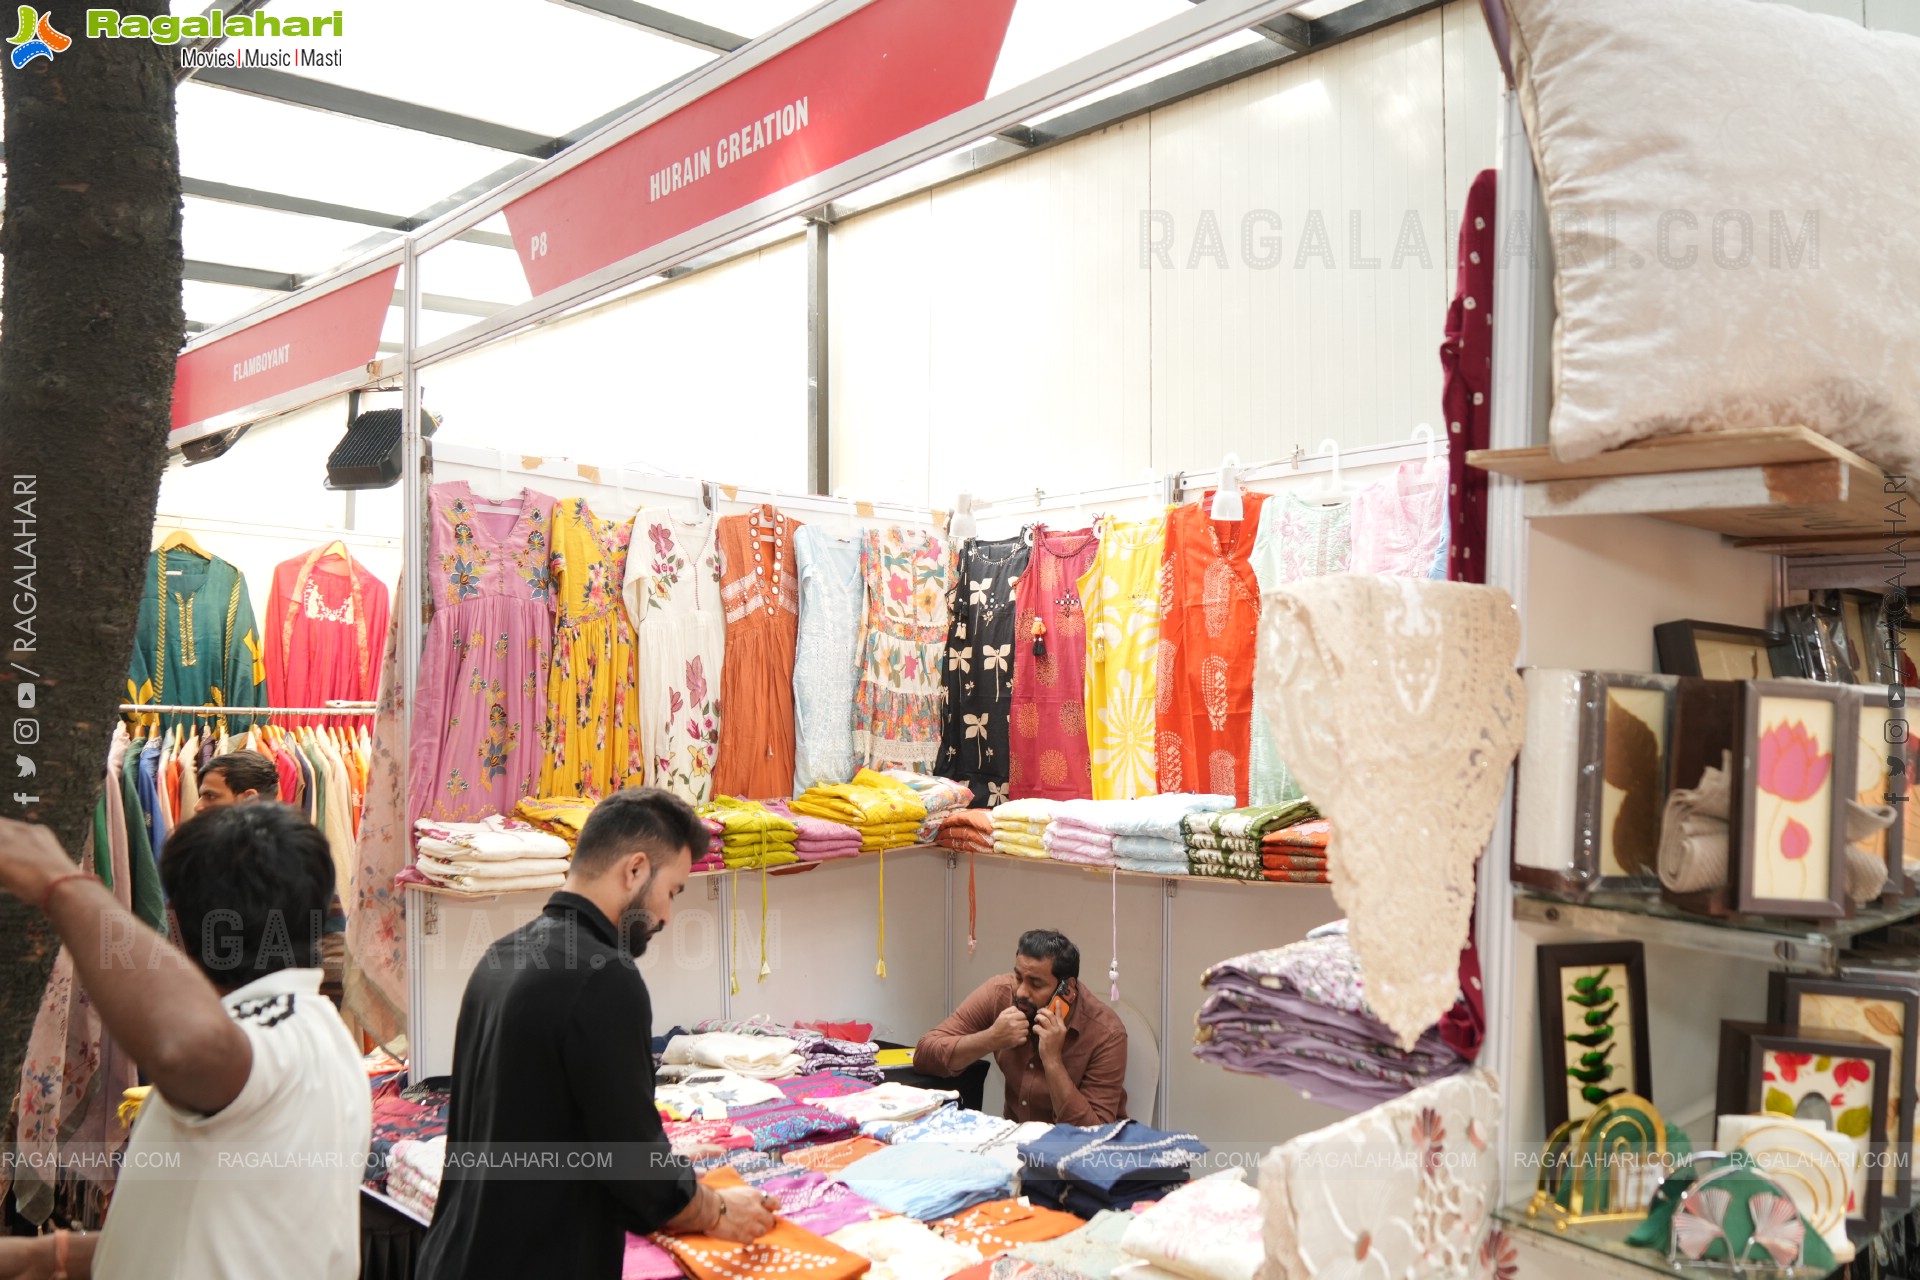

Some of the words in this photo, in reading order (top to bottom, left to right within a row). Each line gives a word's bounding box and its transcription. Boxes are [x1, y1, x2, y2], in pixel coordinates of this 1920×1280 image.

[650, 146, 711, 202] HURAIN
[717, 96, 808, 169] CREATION
[531, 231, 548, 260] P8
[233, 343, 290, 383] FLAMBOYANT
